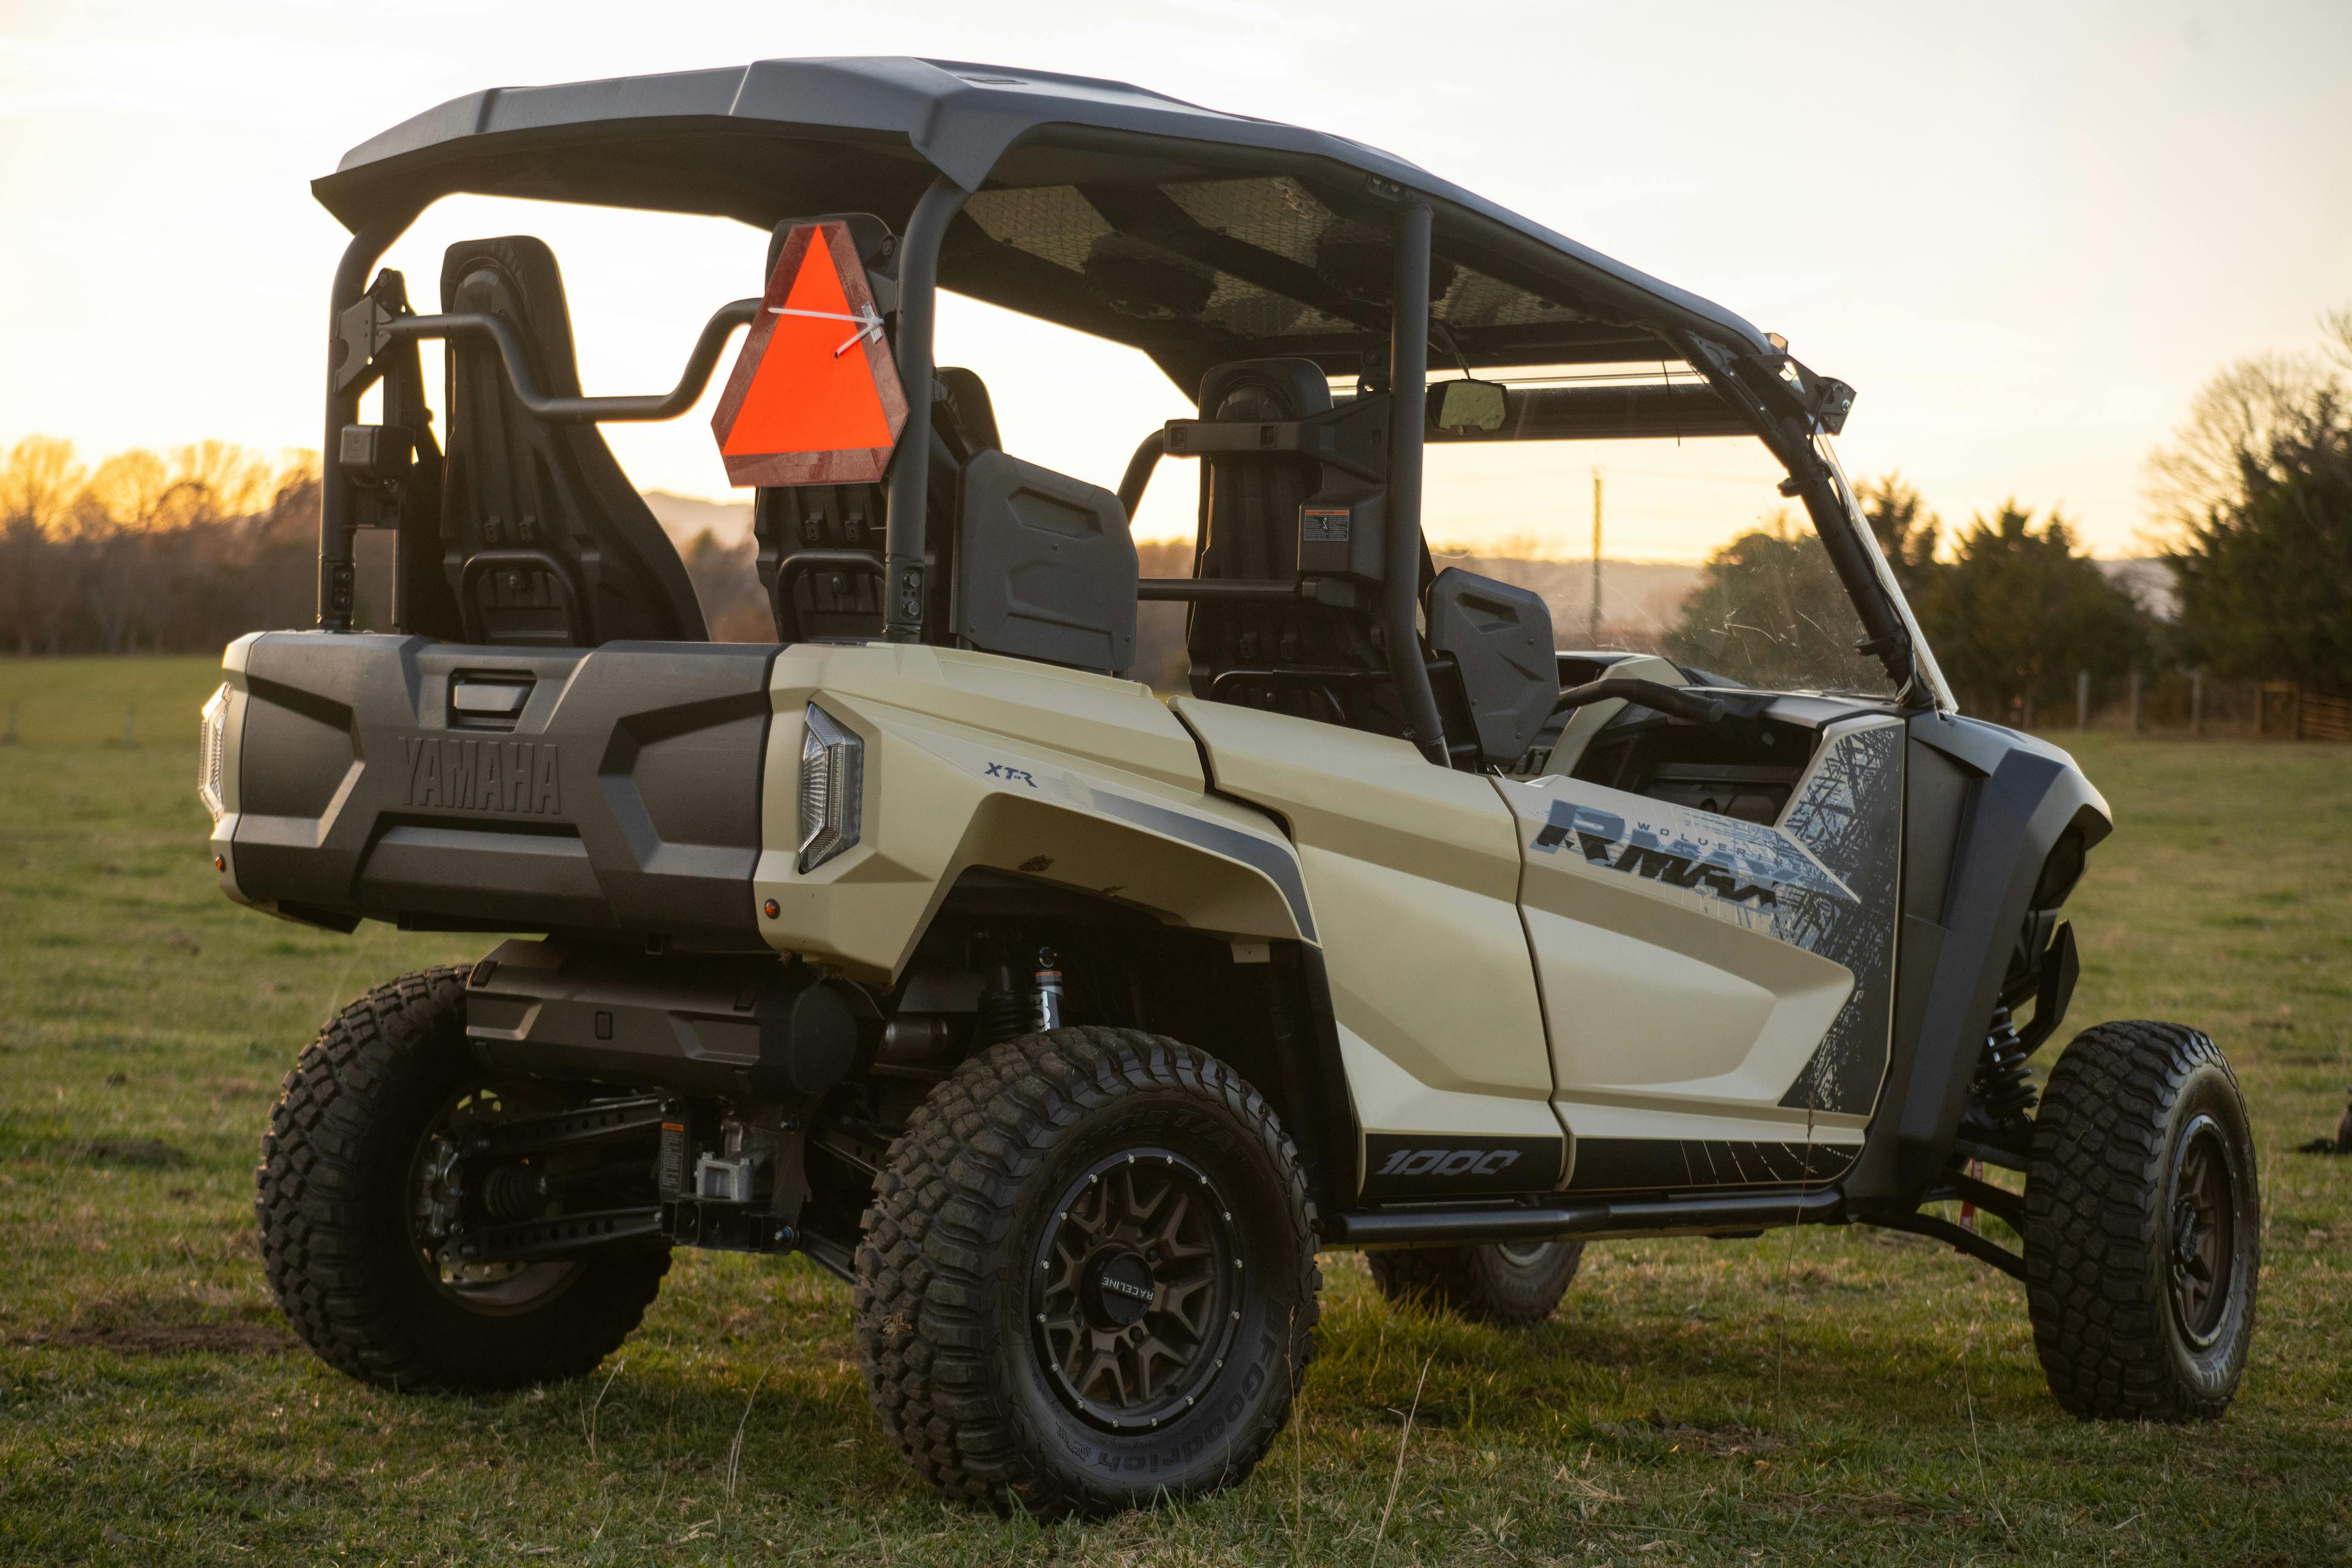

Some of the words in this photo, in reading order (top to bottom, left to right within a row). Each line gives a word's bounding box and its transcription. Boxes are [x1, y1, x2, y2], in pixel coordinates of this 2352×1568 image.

[397, 736, 561, 815] YAMAHA
[1376, 1149, 1523, 1176] 1000
[1101, 1276, 1155, 1301] RACELINE
[1098, 1298, 1287, 1474] BFGoodrich
